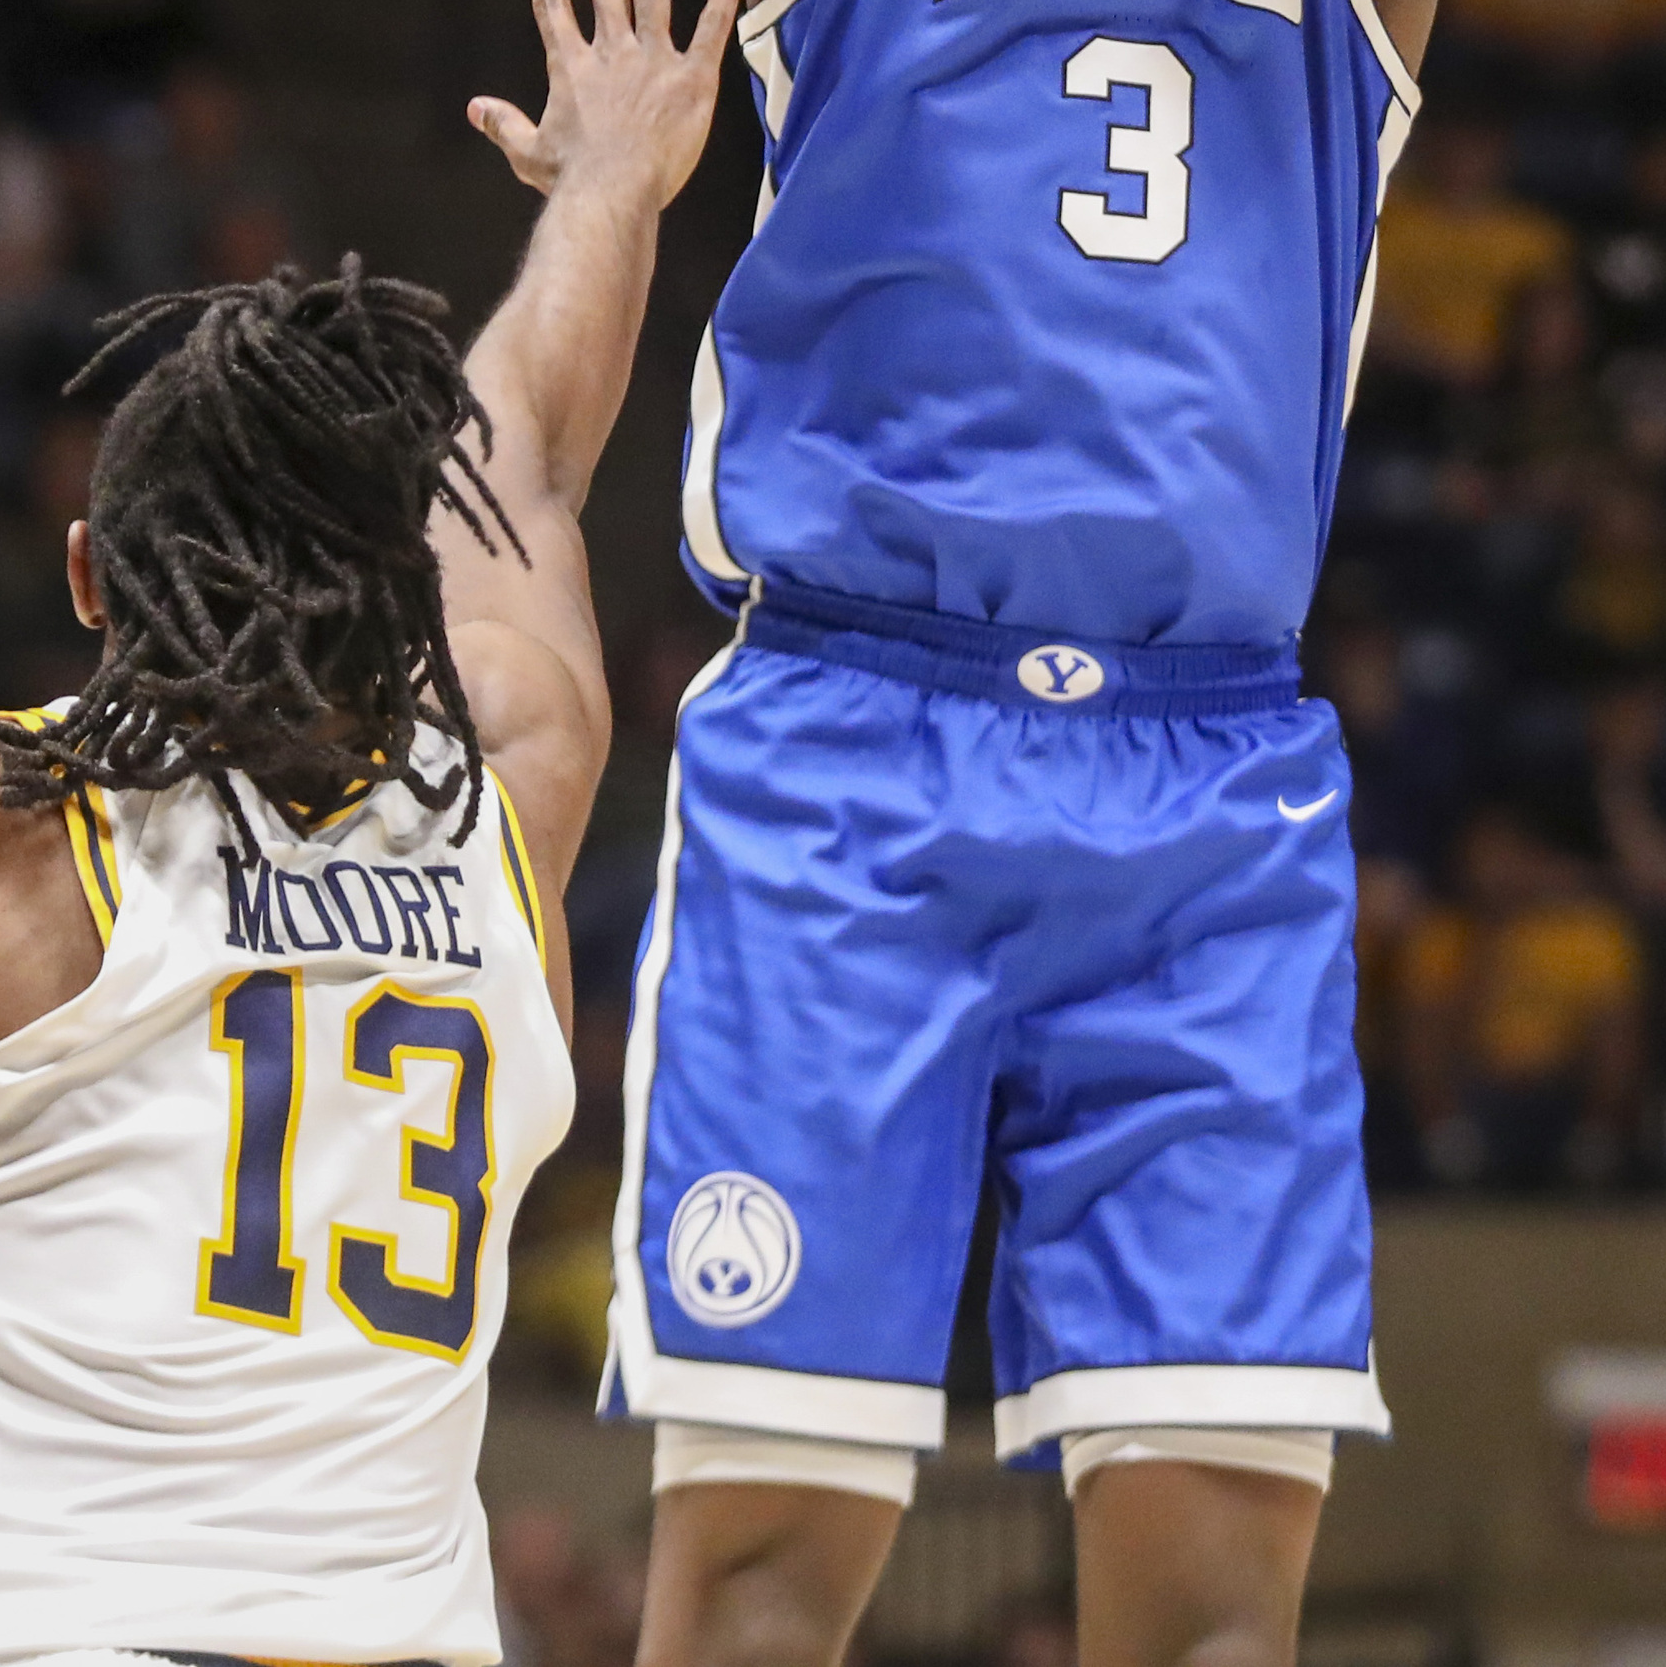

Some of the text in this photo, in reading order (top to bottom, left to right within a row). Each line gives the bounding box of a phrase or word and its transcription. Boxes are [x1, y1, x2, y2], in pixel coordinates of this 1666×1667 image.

[1056, 36, 1195, 265] 3
[1035, 651, 1089, 695] Y
[217, 845, 482, 968] MOORE
[195, 965, 497, 1367] 13
